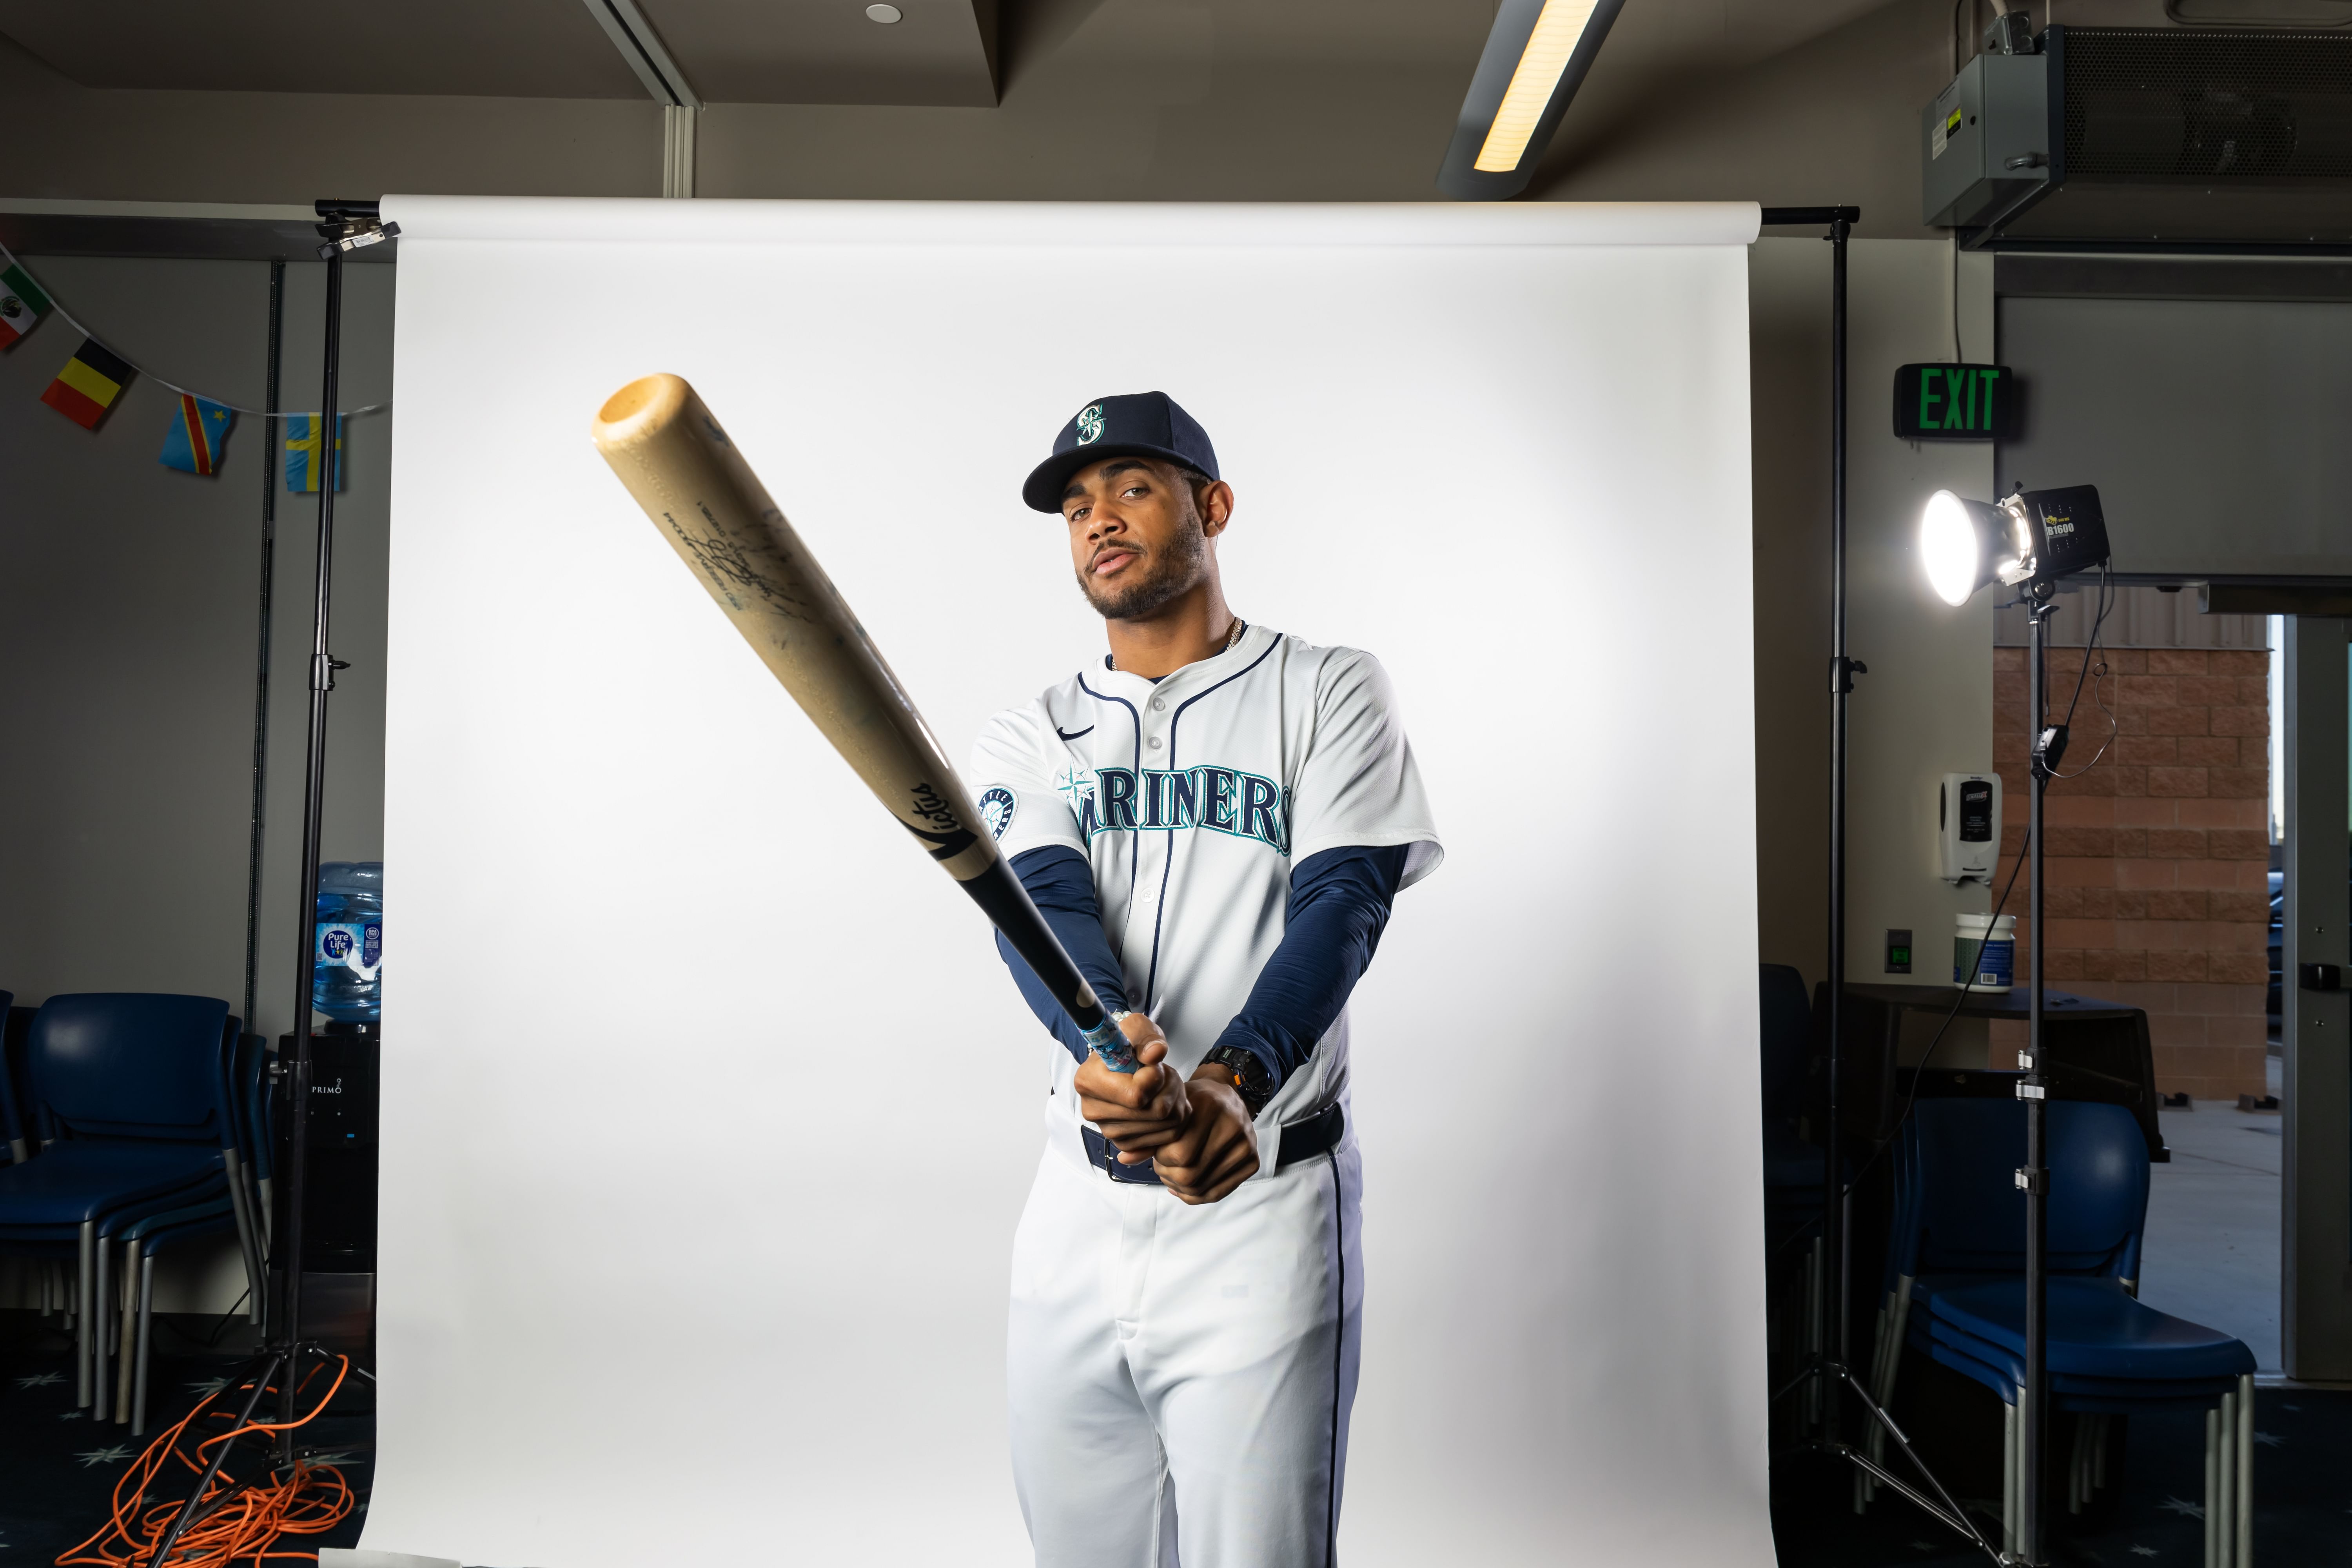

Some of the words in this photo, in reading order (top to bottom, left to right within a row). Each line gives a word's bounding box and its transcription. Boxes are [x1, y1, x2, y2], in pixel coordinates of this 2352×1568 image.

[1919, 368, 1999, 430] EXIT
[2047, 523, 2074, 536] B1600
[892, 783, 979, 862] Victus
[330, 941, 346, 950] Life
